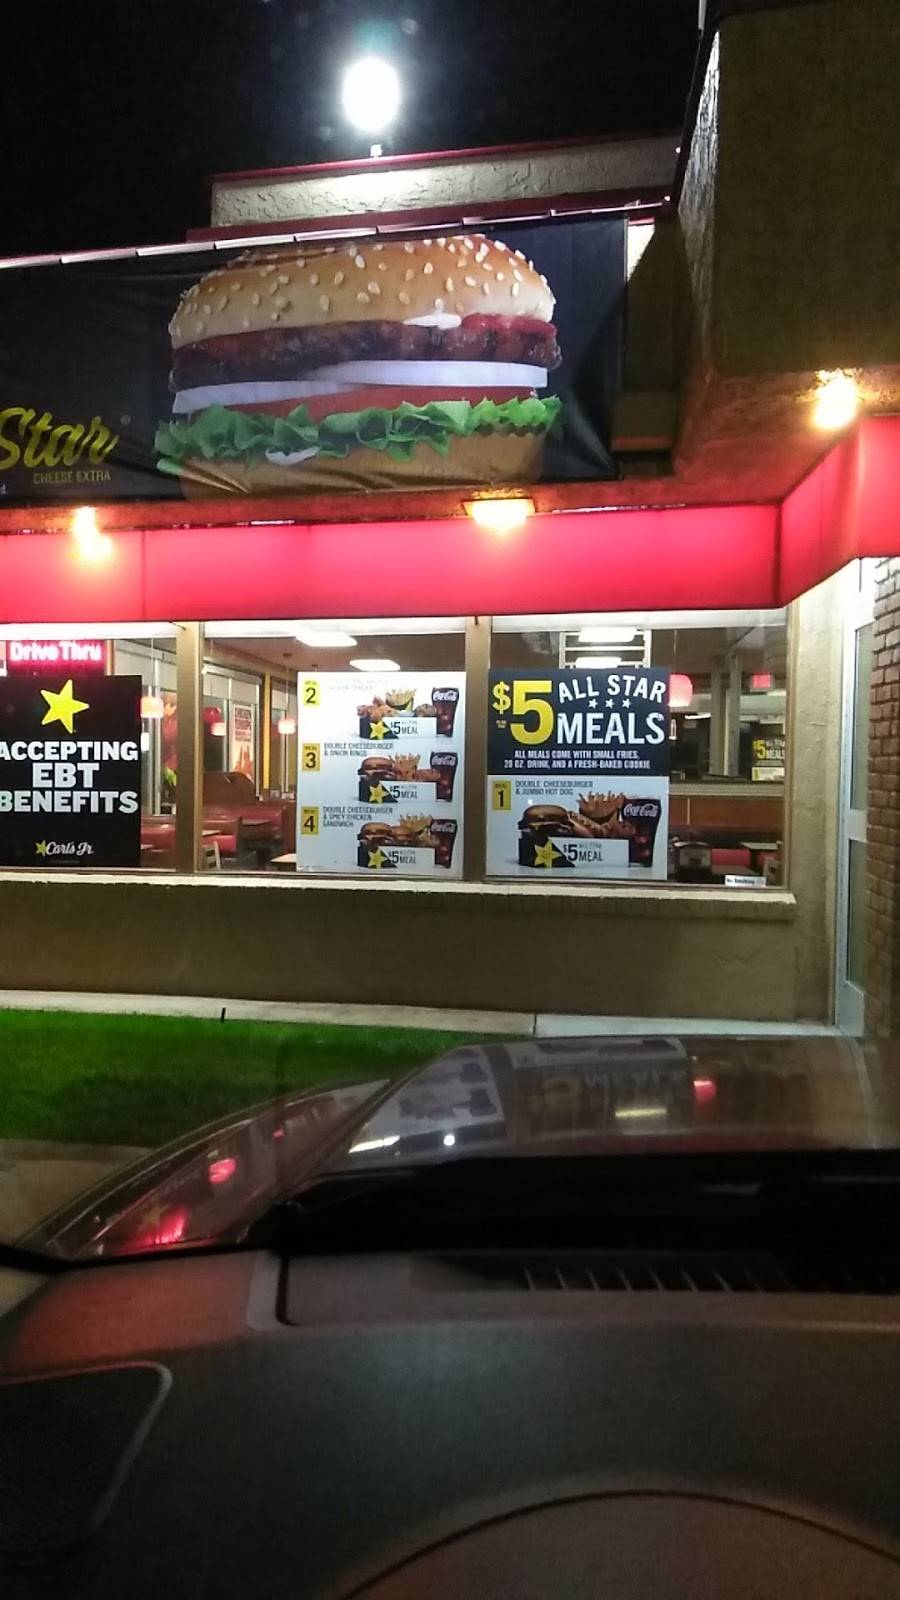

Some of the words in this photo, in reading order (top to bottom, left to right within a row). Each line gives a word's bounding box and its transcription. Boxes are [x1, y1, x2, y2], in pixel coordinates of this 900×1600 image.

[0, 407, 119, 470] Star
[33, 473, 73, 485] CHEESE
[76, 470, 111, 483] EXTRA
[9, 640, 59, 662] Drive
[59, 640, 103, 662] Thru
[305, 687, 317, 705] 2
[558, 676, 599, 703] ALL
[607, 674, 666, 703] STAR
[401, 726, 418, 735] MEAL
[557, 712, 665, 744] MEALS
[0, 741, 139, 761] ACCEPTING
[324, 742, 347, 750] DOUBLE
[514, 750, 526, 759] ALL
[527, 750, 550, 759] MEALS
[551, 750, 571, 759] COME
[573, 750, 592, 759] WITH
[593, 750, 615, 759] SMALL
[305, 752, 316, 769] 3
[551, 759, 566, 769] AND
[567, 759, 573, 769] A
[574, 759, 623, 769] FRESH-BAKED
[624, 760, 650, 769] COOKIE
[32, 762, 100, 788] EBT
[0, 790, 139, 814] BENEFITS
[400, 791, 418, 799] MEAL
[498, 789, 505, 808] 1
[303, 815, 316, 832] 4
[399, 856, 417, 865] MEAL
[579, 851, 603, 862] MEAL
